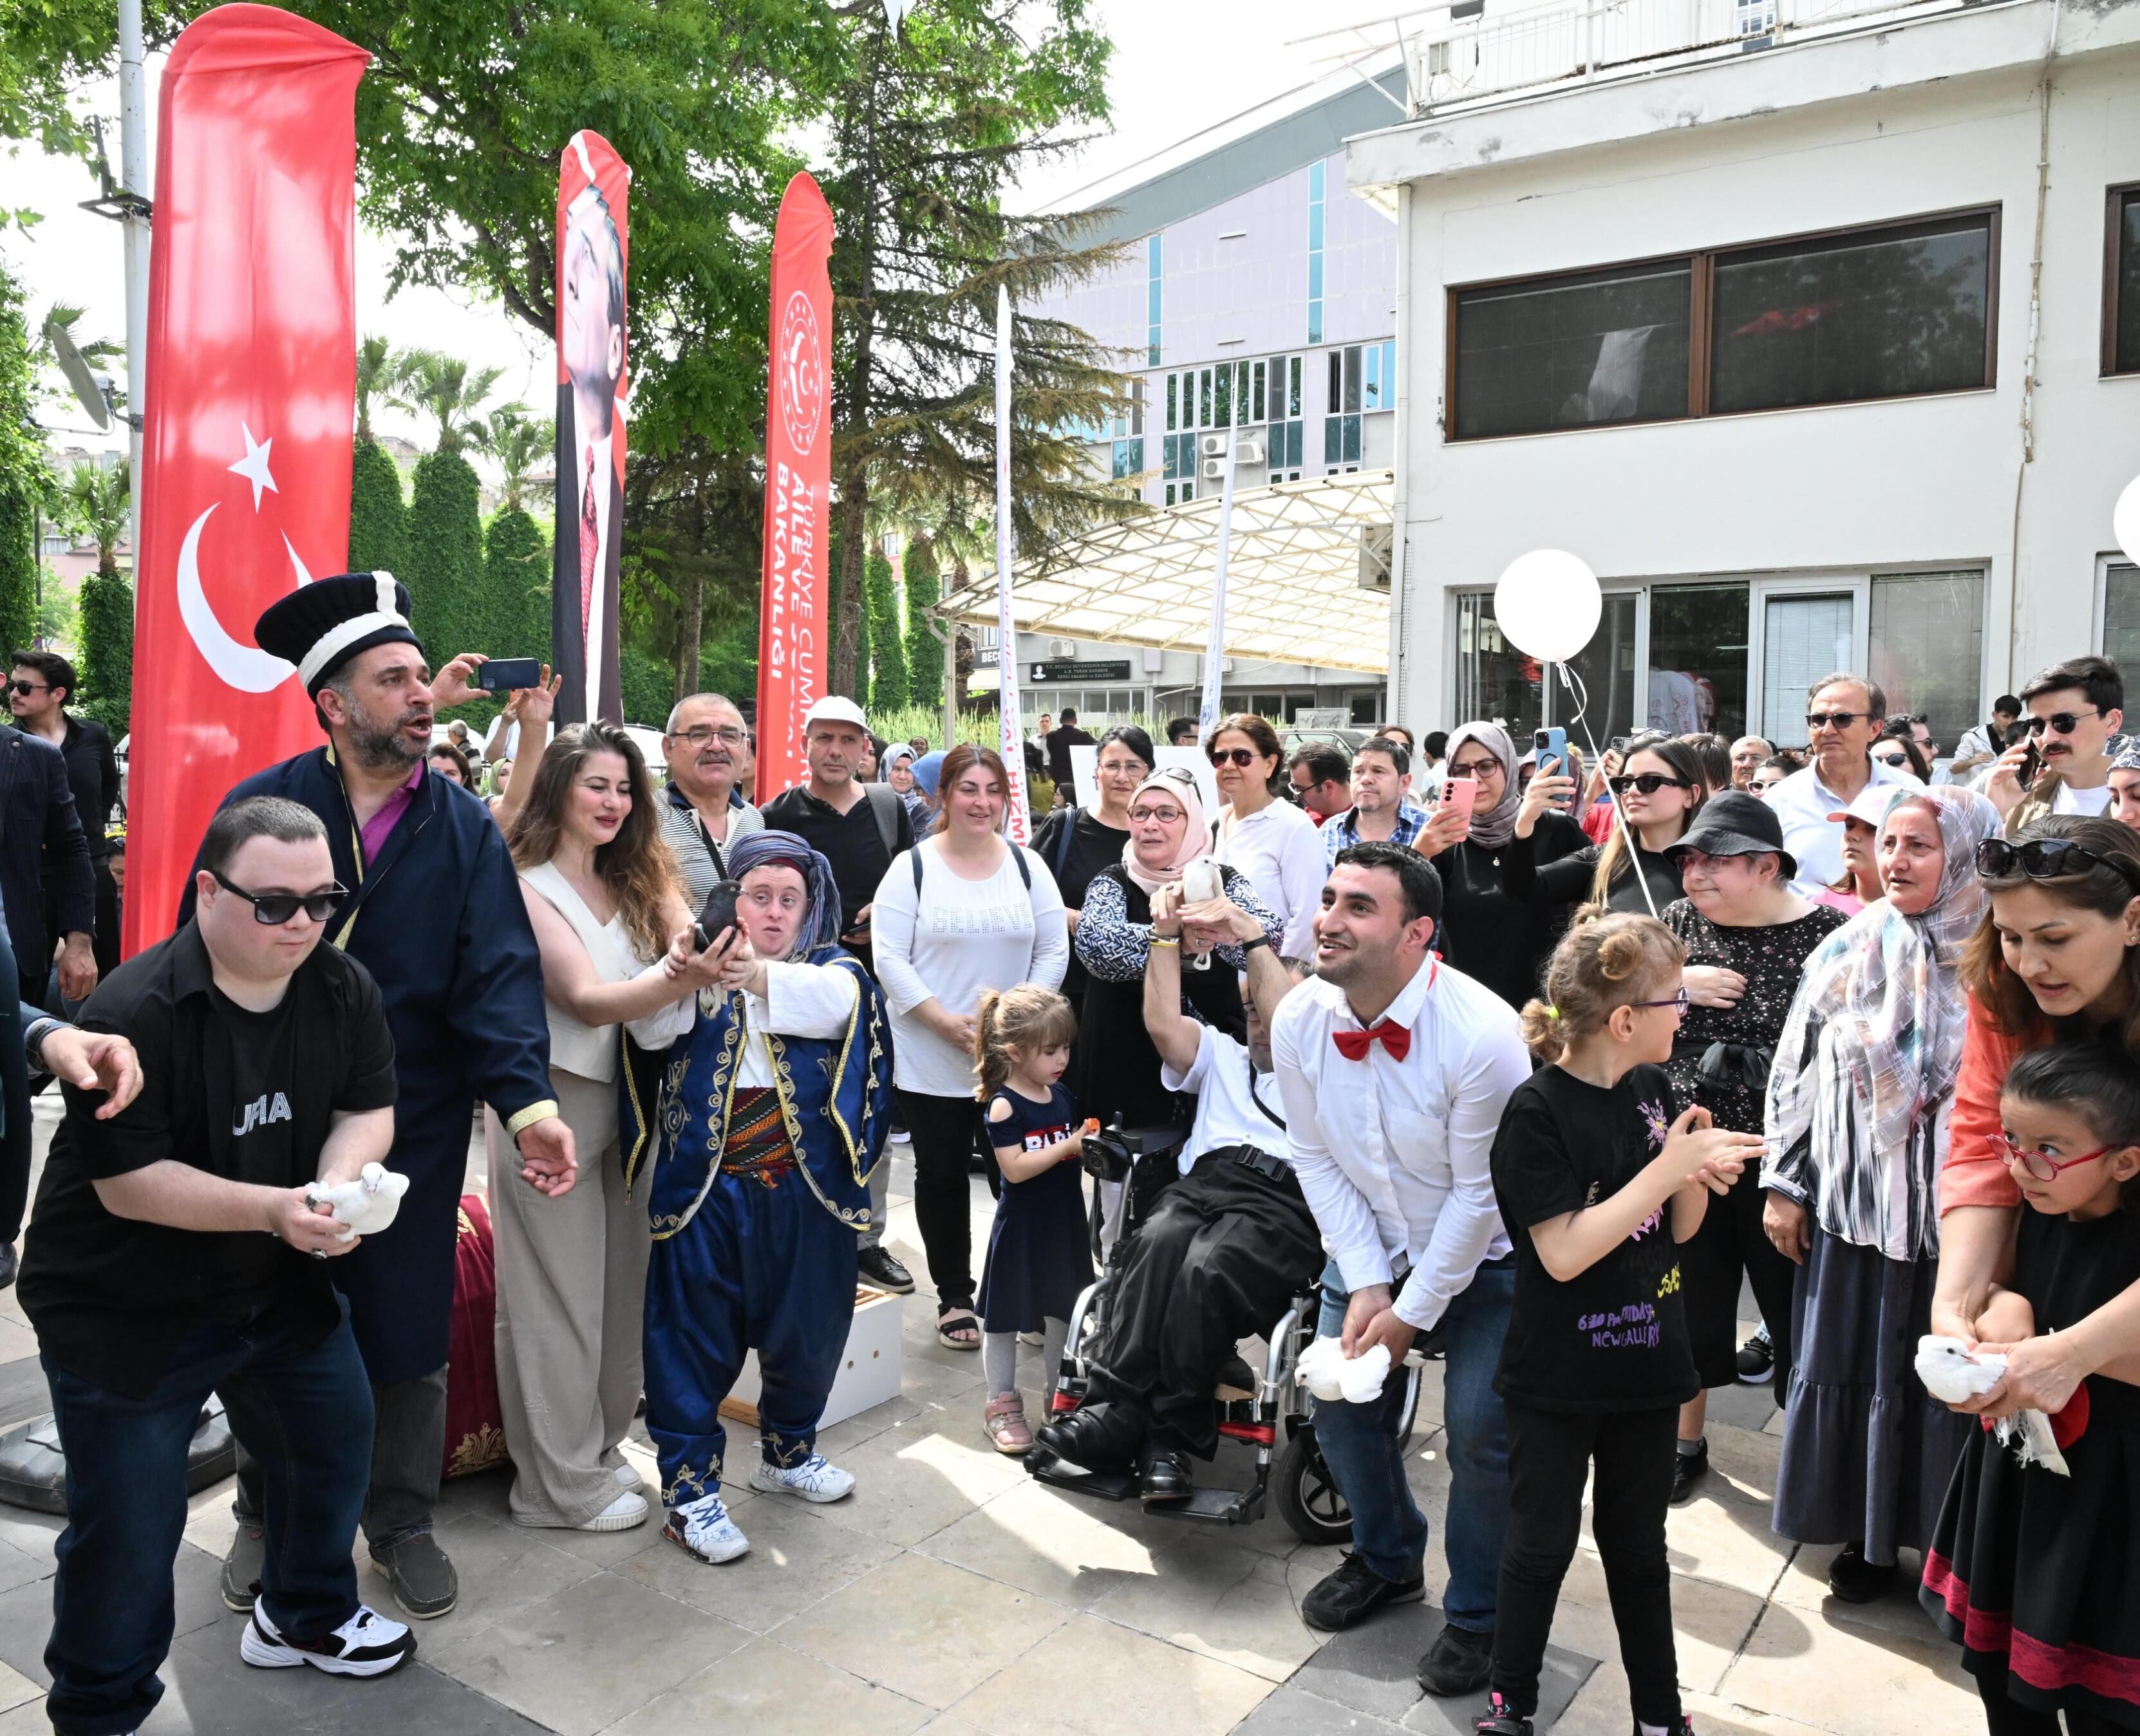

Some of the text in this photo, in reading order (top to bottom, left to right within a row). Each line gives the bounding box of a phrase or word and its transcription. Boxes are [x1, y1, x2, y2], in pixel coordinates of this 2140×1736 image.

[771, 462, 789, 679] BAKANLIĞI
[791, 567, 802, 611] VE
[800, 485, 815, 619] TÜRKİYE
